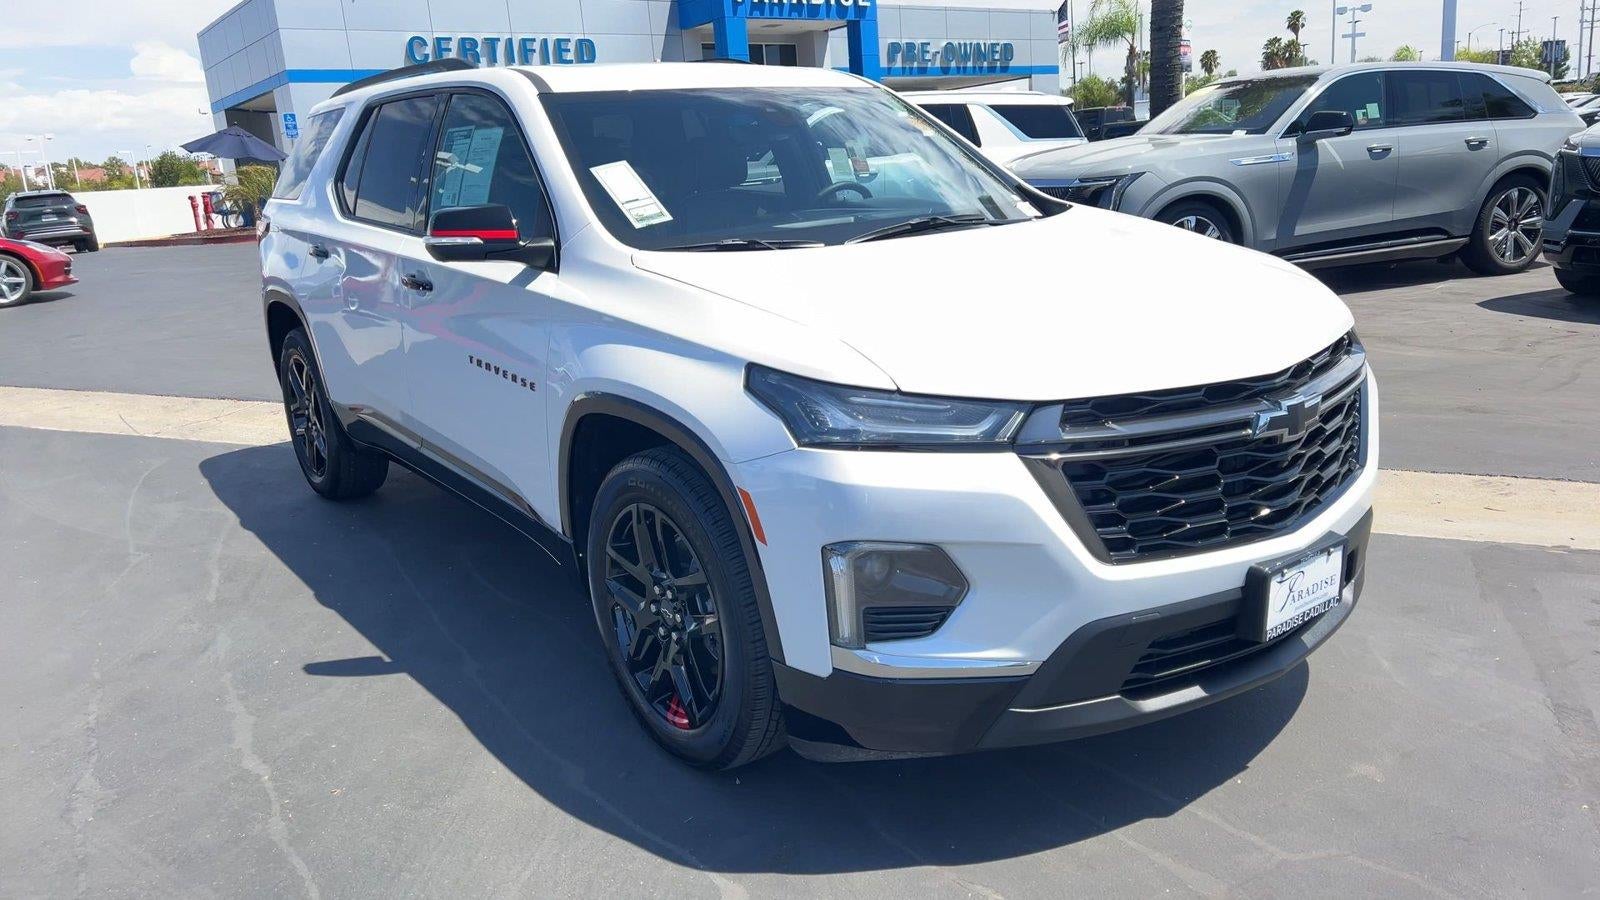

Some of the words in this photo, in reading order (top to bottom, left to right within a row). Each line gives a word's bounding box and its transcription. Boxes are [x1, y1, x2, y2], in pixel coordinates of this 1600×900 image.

[405, 35, 597, 66] CERTIFIED
[887, 41, 1014, 63] PRE-OWNED
[468, 355, 536, 392] TRAVERSE
[1275, 570, 1337, 613] PARADISE
[1266, 613, 1303, 642] PARADISE
[1304, 596, 1340, 621] CADILLAC
